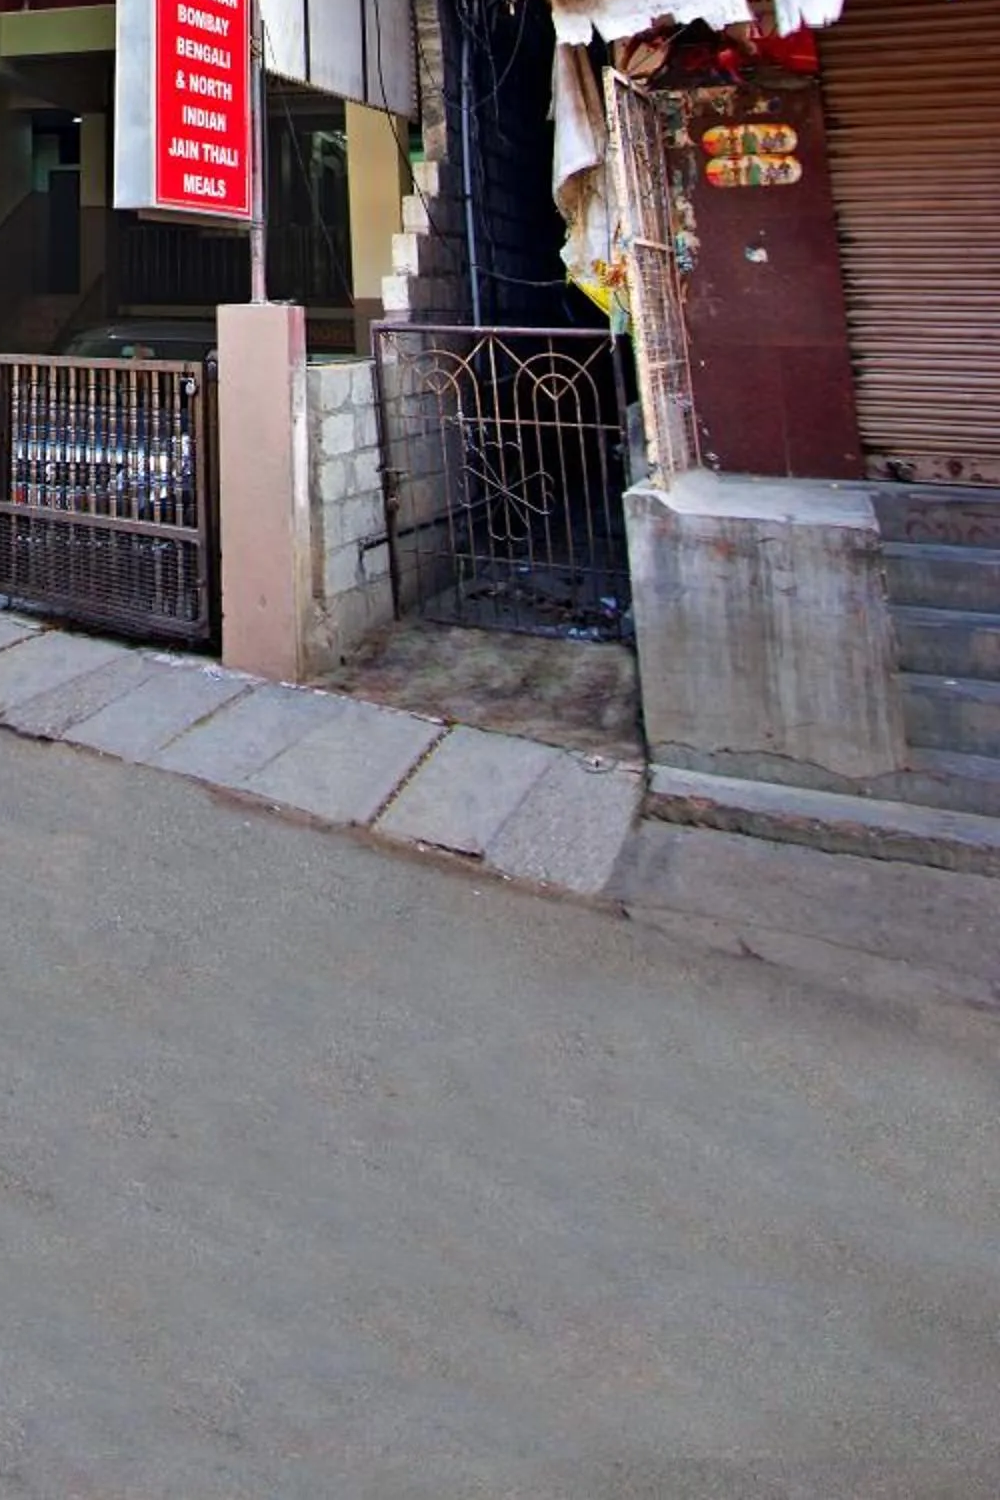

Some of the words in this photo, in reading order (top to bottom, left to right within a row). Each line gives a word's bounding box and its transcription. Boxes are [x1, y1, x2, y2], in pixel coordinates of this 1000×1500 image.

[177, 3, 230, 37] BOMBAY
[176, 36, 232, 69] BENGALI
[175, 68, 186, 90] &
[189, 73, 233, 101] NORTH
[182, 104, 227, 133] INDIAN
[168, 137, 200, 161] JAIN
[201, 142, 240, 168] THALI
[183, 172, 227, 199] MEALS
